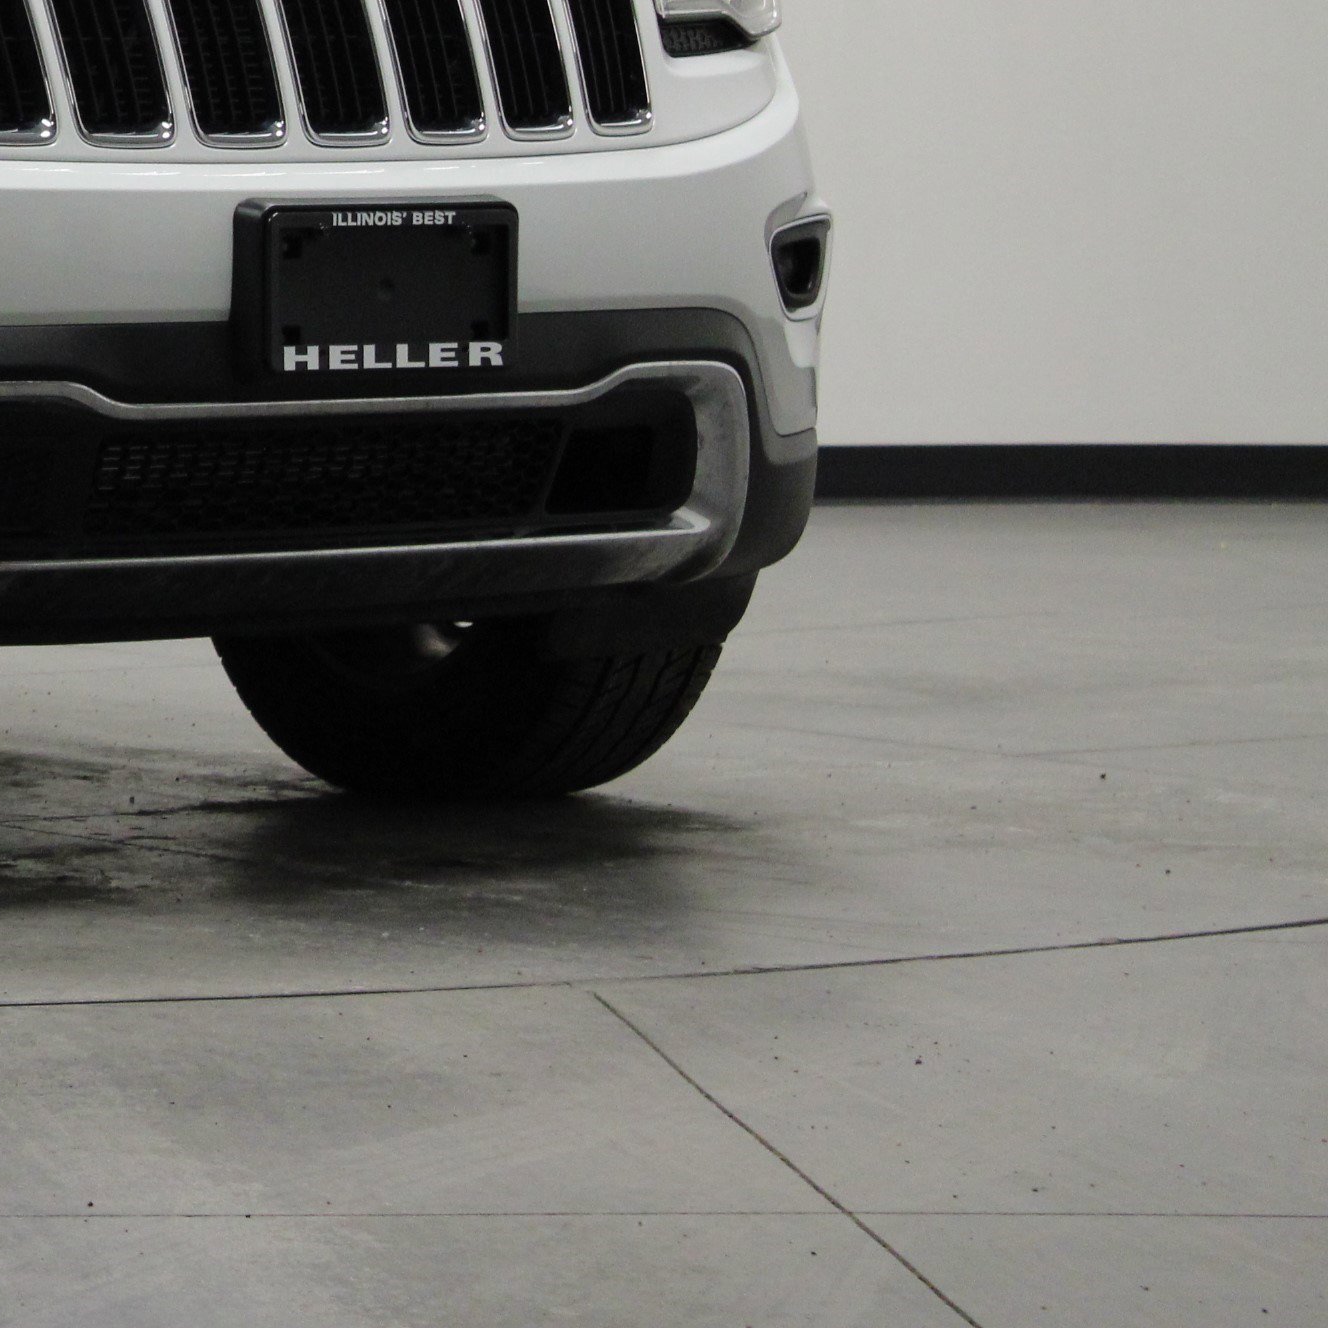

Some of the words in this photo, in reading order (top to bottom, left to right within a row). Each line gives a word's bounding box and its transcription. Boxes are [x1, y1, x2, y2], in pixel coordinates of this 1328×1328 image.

[332, 210, 408, 228] ILLINOIS'
[411, 210, 457, 227] BEST
[282, 340, 505, 372] HELLER
